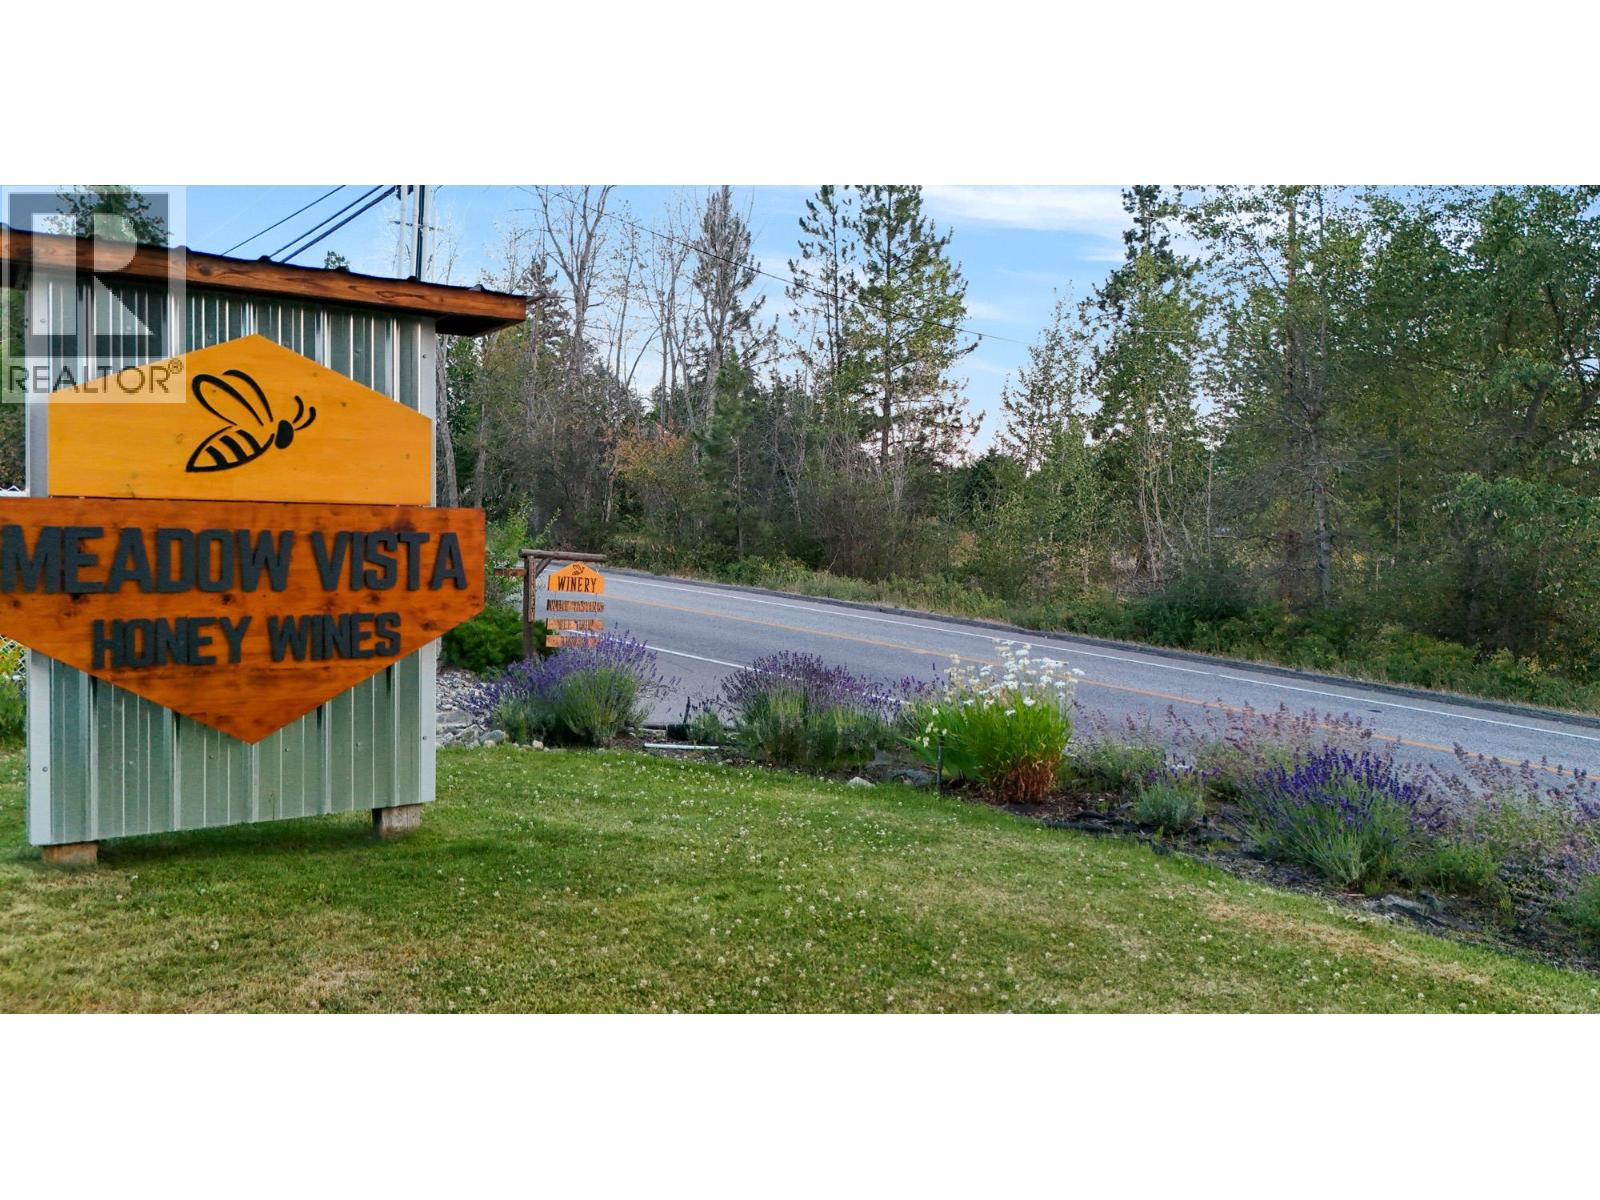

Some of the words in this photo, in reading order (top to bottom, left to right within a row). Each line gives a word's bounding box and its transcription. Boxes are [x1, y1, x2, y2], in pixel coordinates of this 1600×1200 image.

[1, 525, 294, 593] MEADOW
[310, 531, 467, 591] VISTA
[557, 575, 597, 593] WINERY
[91, 614, 252, 669] HONEY
[267, 612, 401, 662] WINES
